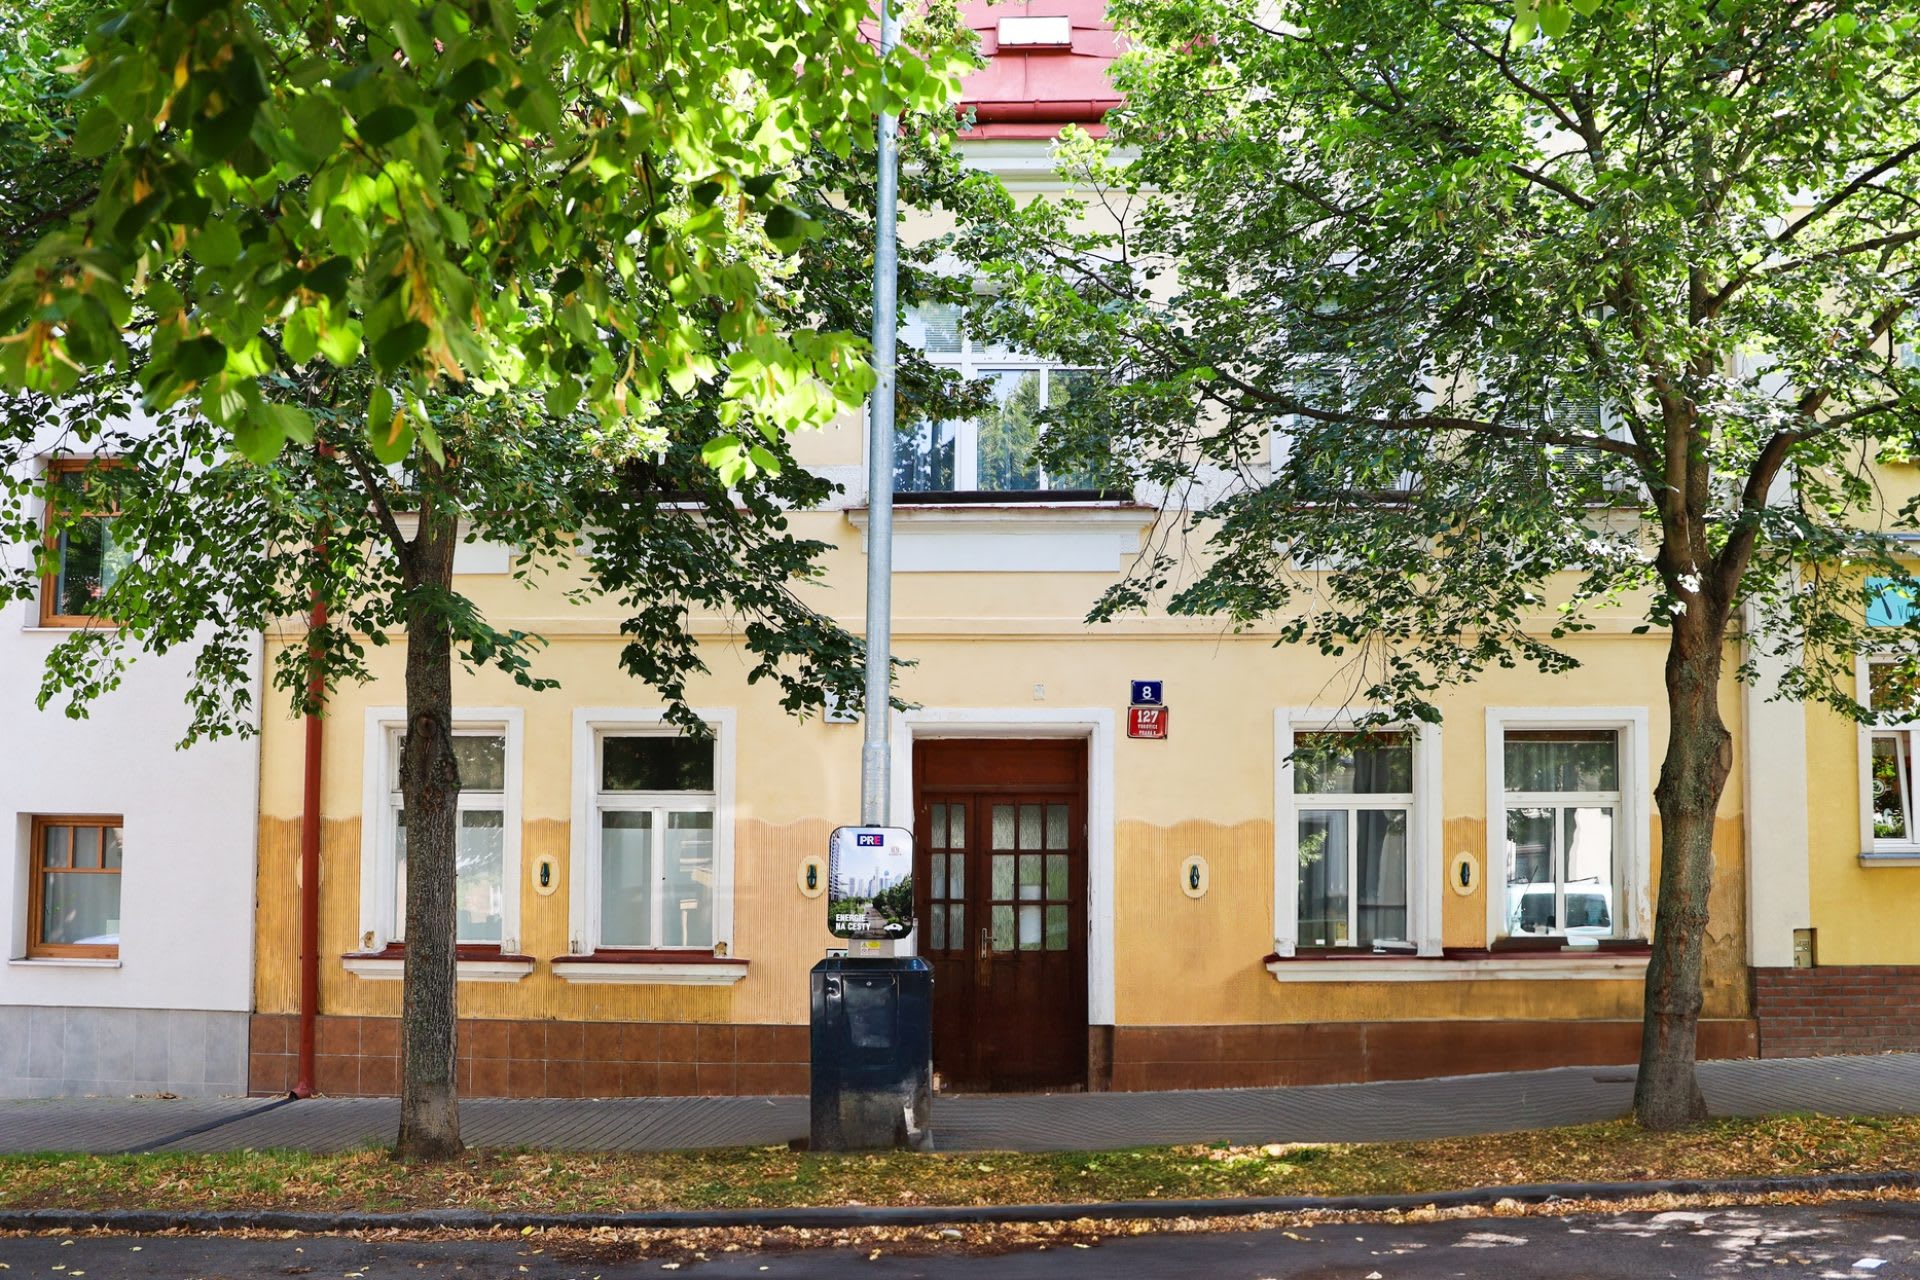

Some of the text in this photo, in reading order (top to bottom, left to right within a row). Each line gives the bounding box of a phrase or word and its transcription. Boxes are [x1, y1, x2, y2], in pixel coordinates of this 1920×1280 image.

[1142, 686, 1152, 699] 8
[1137, 710, 1159, 723] 127
[859, 836, 881, 845] PRE
[836, 914, 867, 922] ENERGIE
[836, 922, 871, 931] NA CESTY
